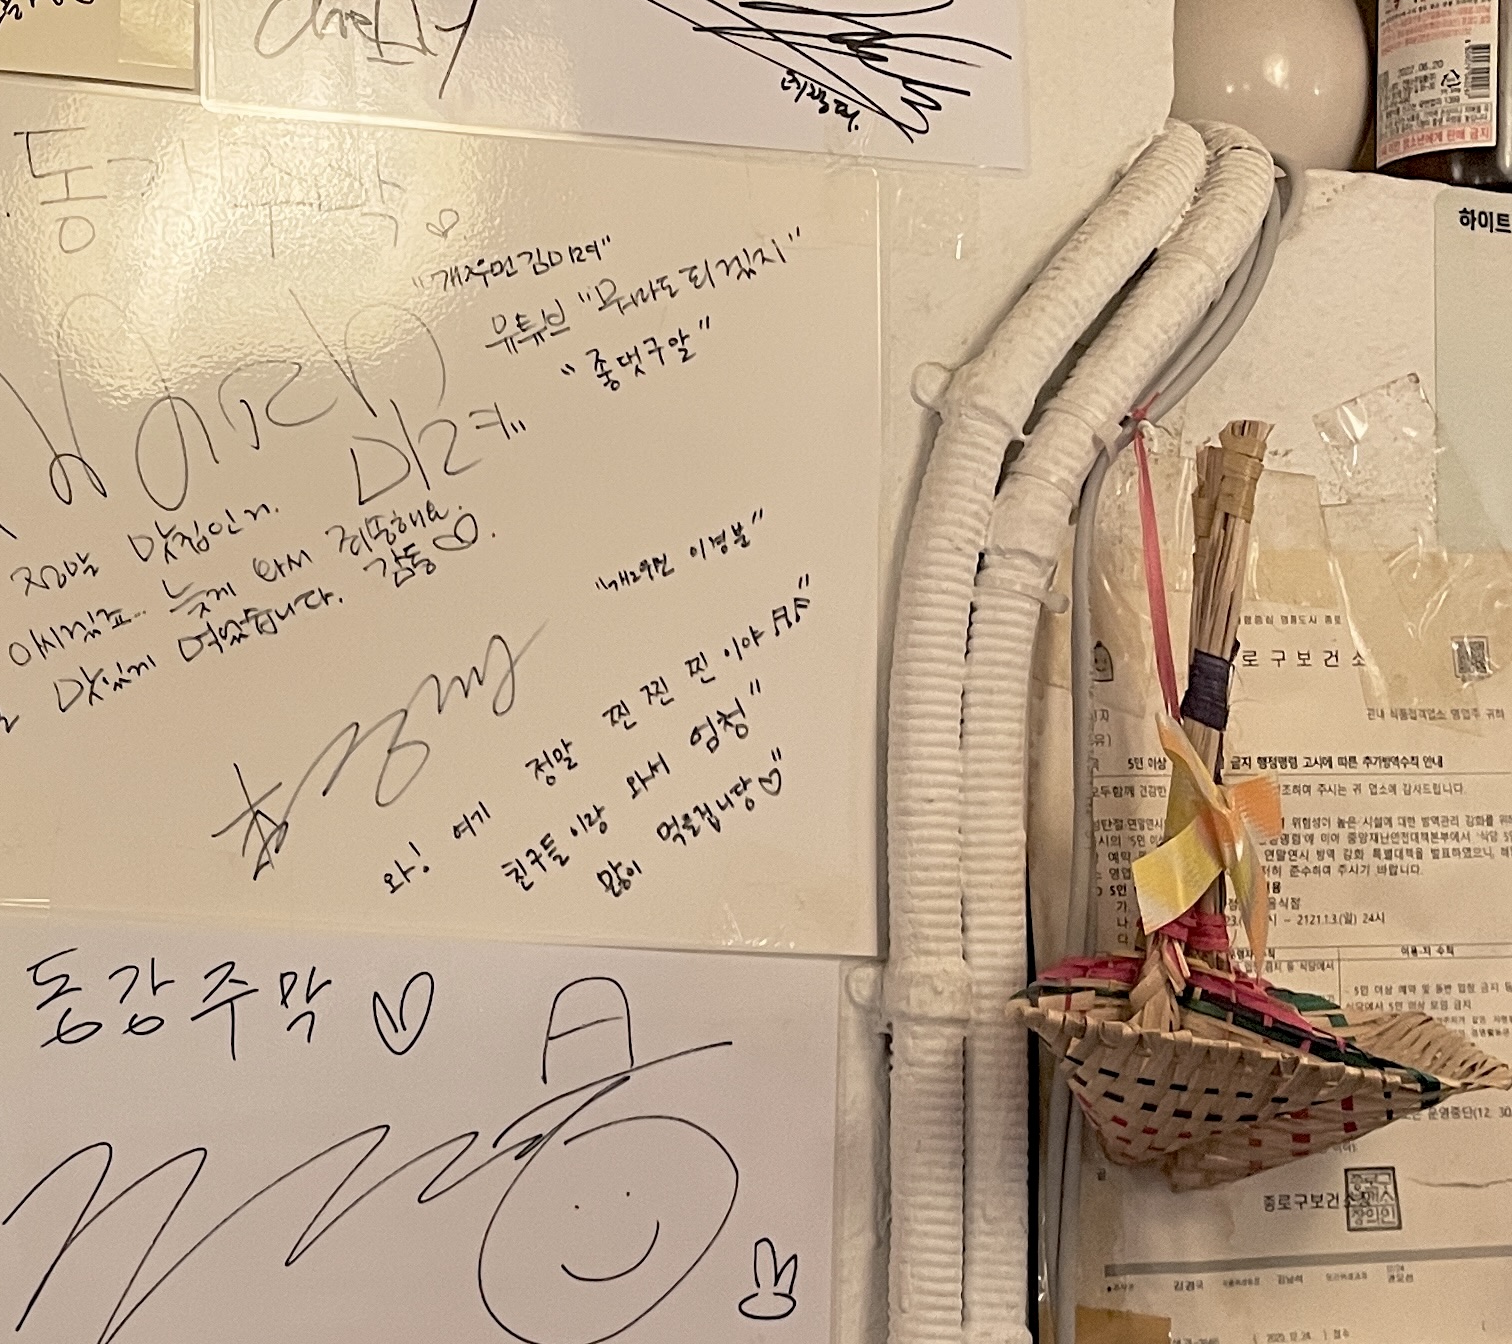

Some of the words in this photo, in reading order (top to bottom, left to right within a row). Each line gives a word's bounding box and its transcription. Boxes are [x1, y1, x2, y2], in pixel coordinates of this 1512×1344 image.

[484, 298, 571, 355] 유튜브
[452, 800, 492, 840] 여기
[524, 738, 579, 787] 정말
[500, 832, 571, 892] 친구들
[626, 751, 671, 801] 와서
[596, 859, 643, 898] 많이
[25, 947, 333, 1062] 동강주막
